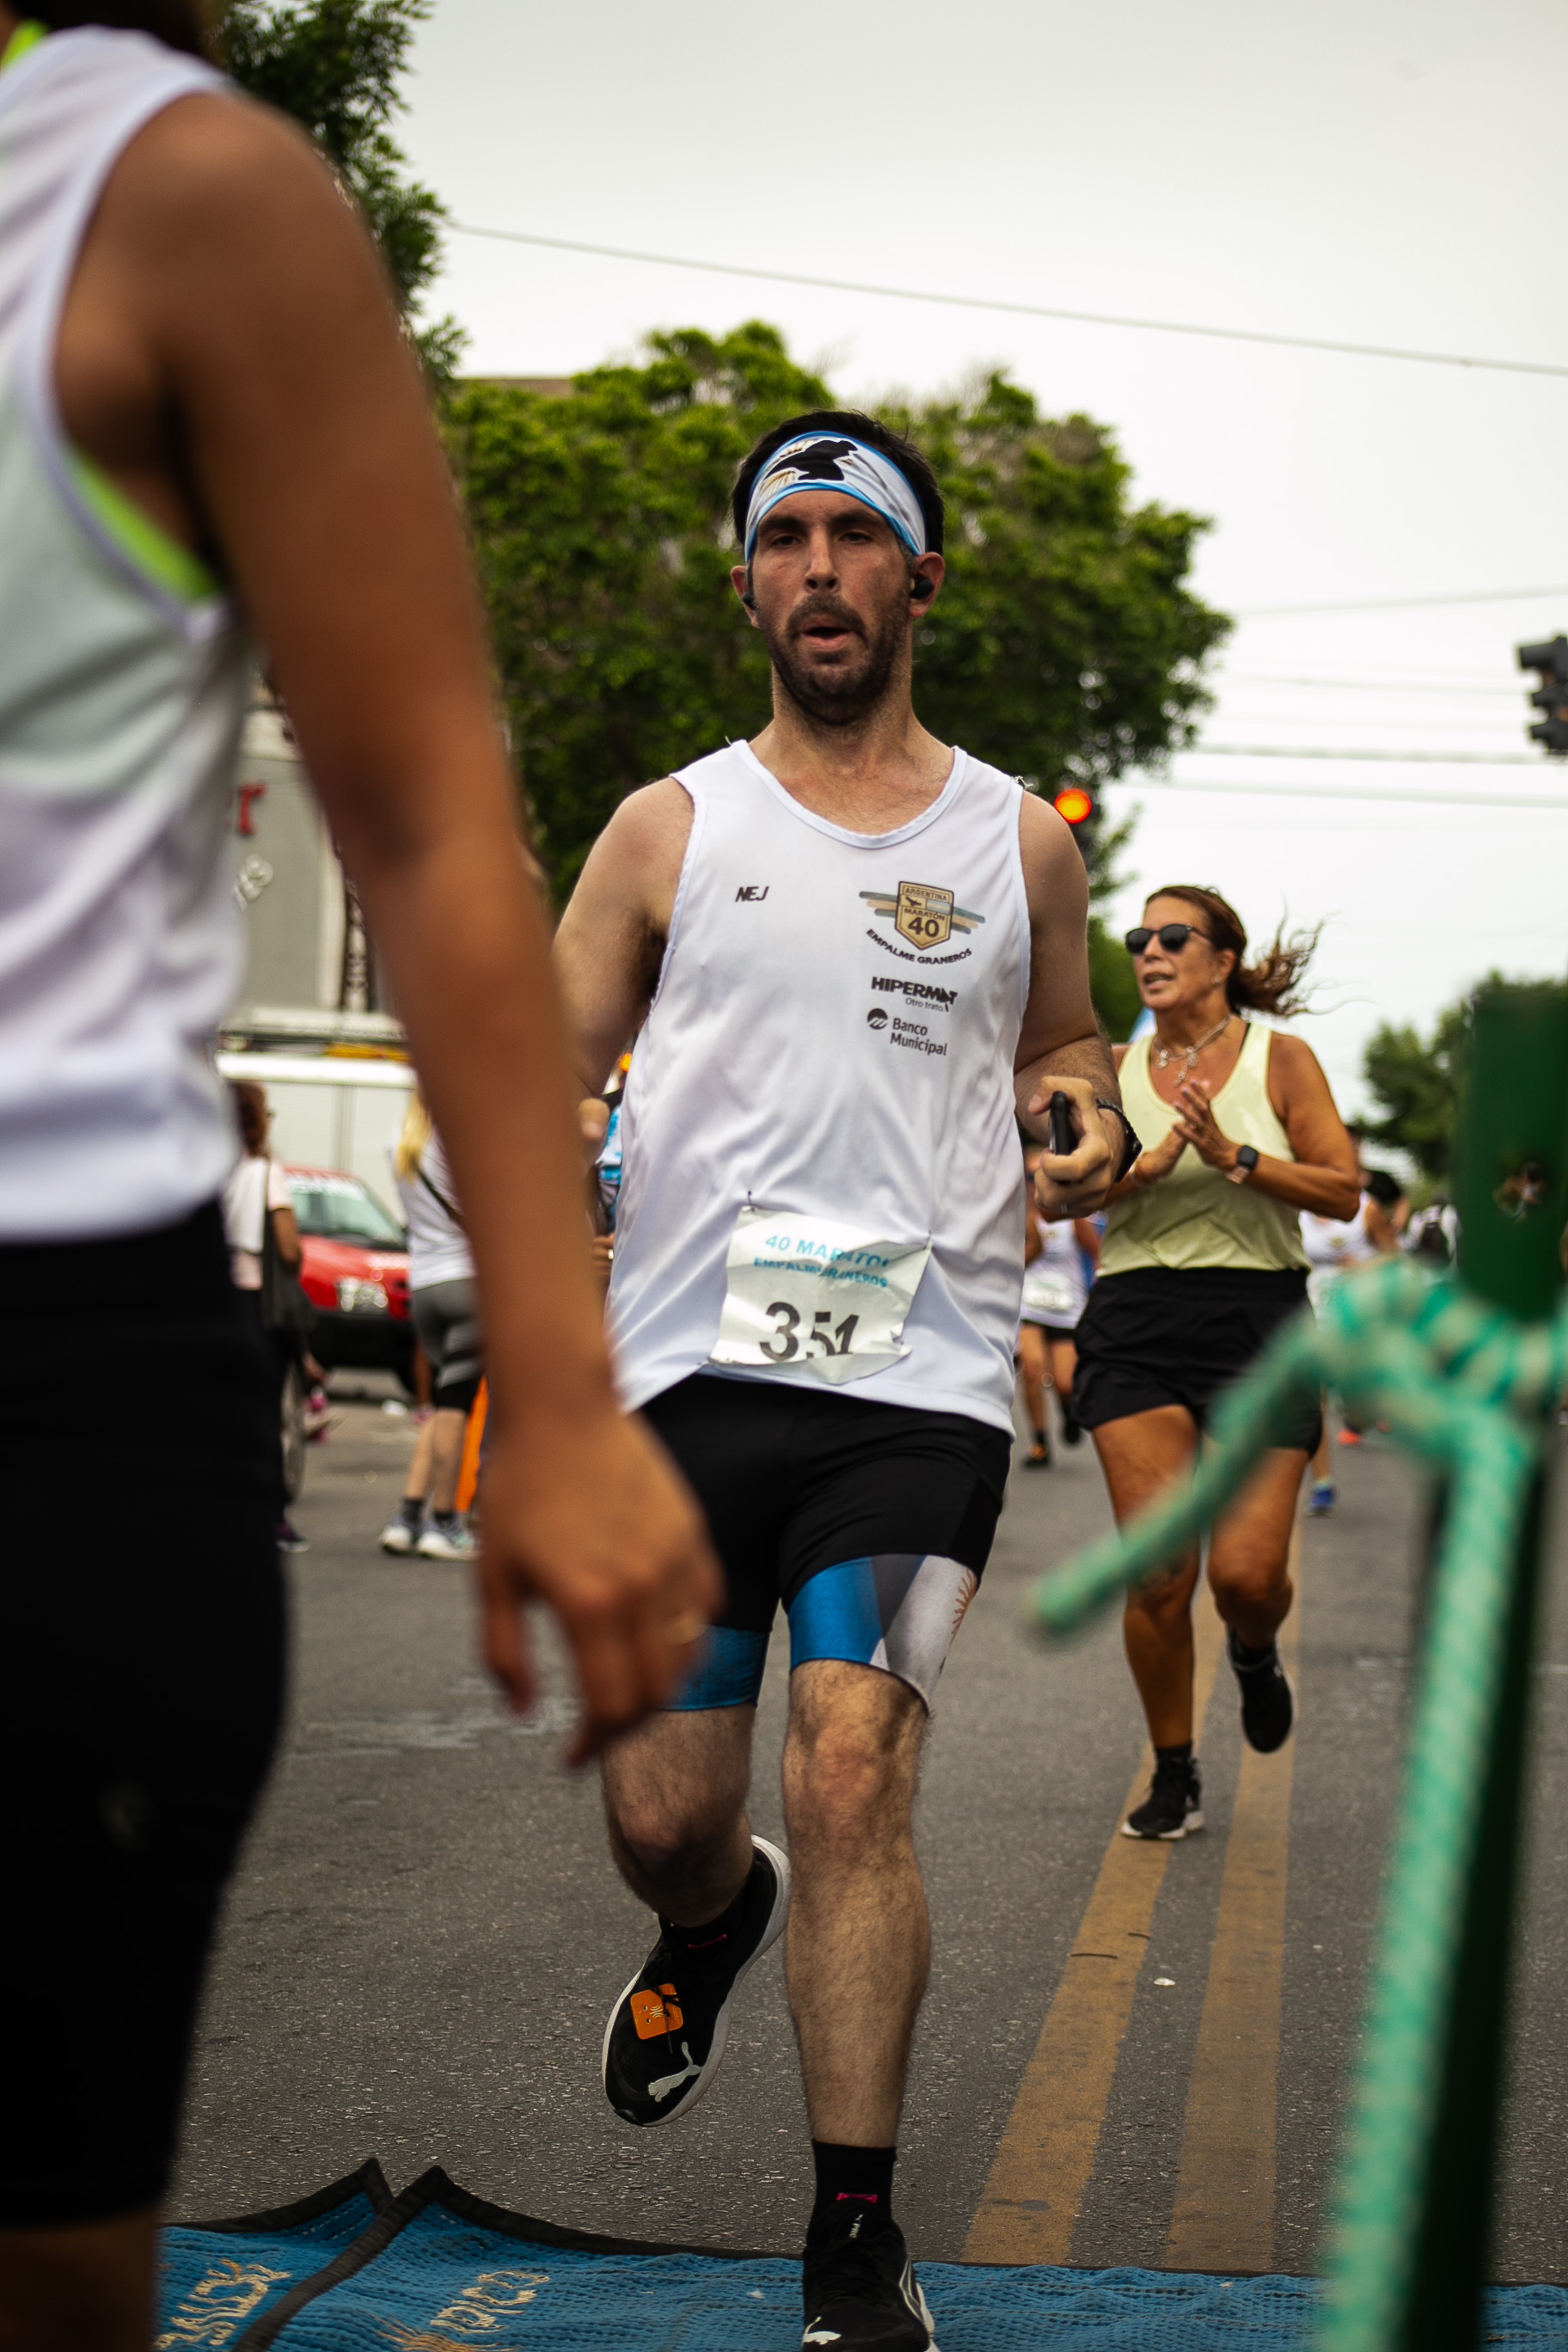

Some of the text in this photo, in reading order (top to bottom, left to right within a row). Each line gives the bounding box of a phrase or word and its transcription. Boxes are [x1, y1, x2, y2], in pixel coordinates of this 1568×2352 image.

[905, 887, 947, 901] ARGENTINA
[904, 908, 946, 922] MARATÓN
[908, 917, 940, 938] 40
[867, 929, 972, 965] EMPALME GRANEROS
[905, 998, 923, 1008] Otro
[892, 1018, 928, 1036] Banco
[890, 1032, 947, 1056] Municipal
[766, 1236, 791, 1251] 40
[760, 1302, 860, 1363] 351
